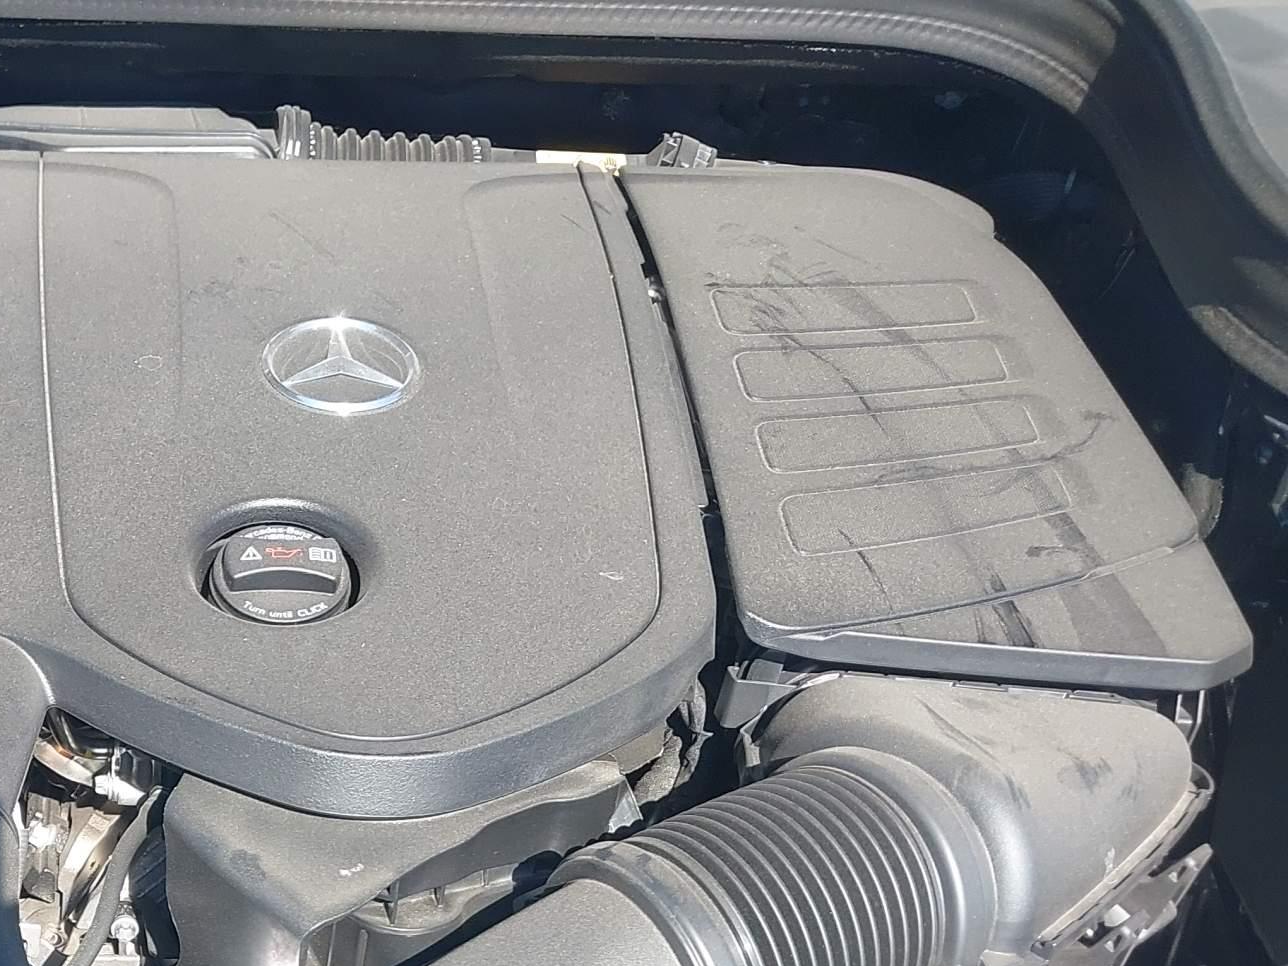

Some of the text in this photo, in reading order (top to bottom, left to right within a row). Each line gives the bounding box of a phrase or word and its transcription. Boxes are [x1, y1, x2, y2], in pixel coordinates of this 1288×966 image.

[243, 600, 328, 618] Turn until CLICK
